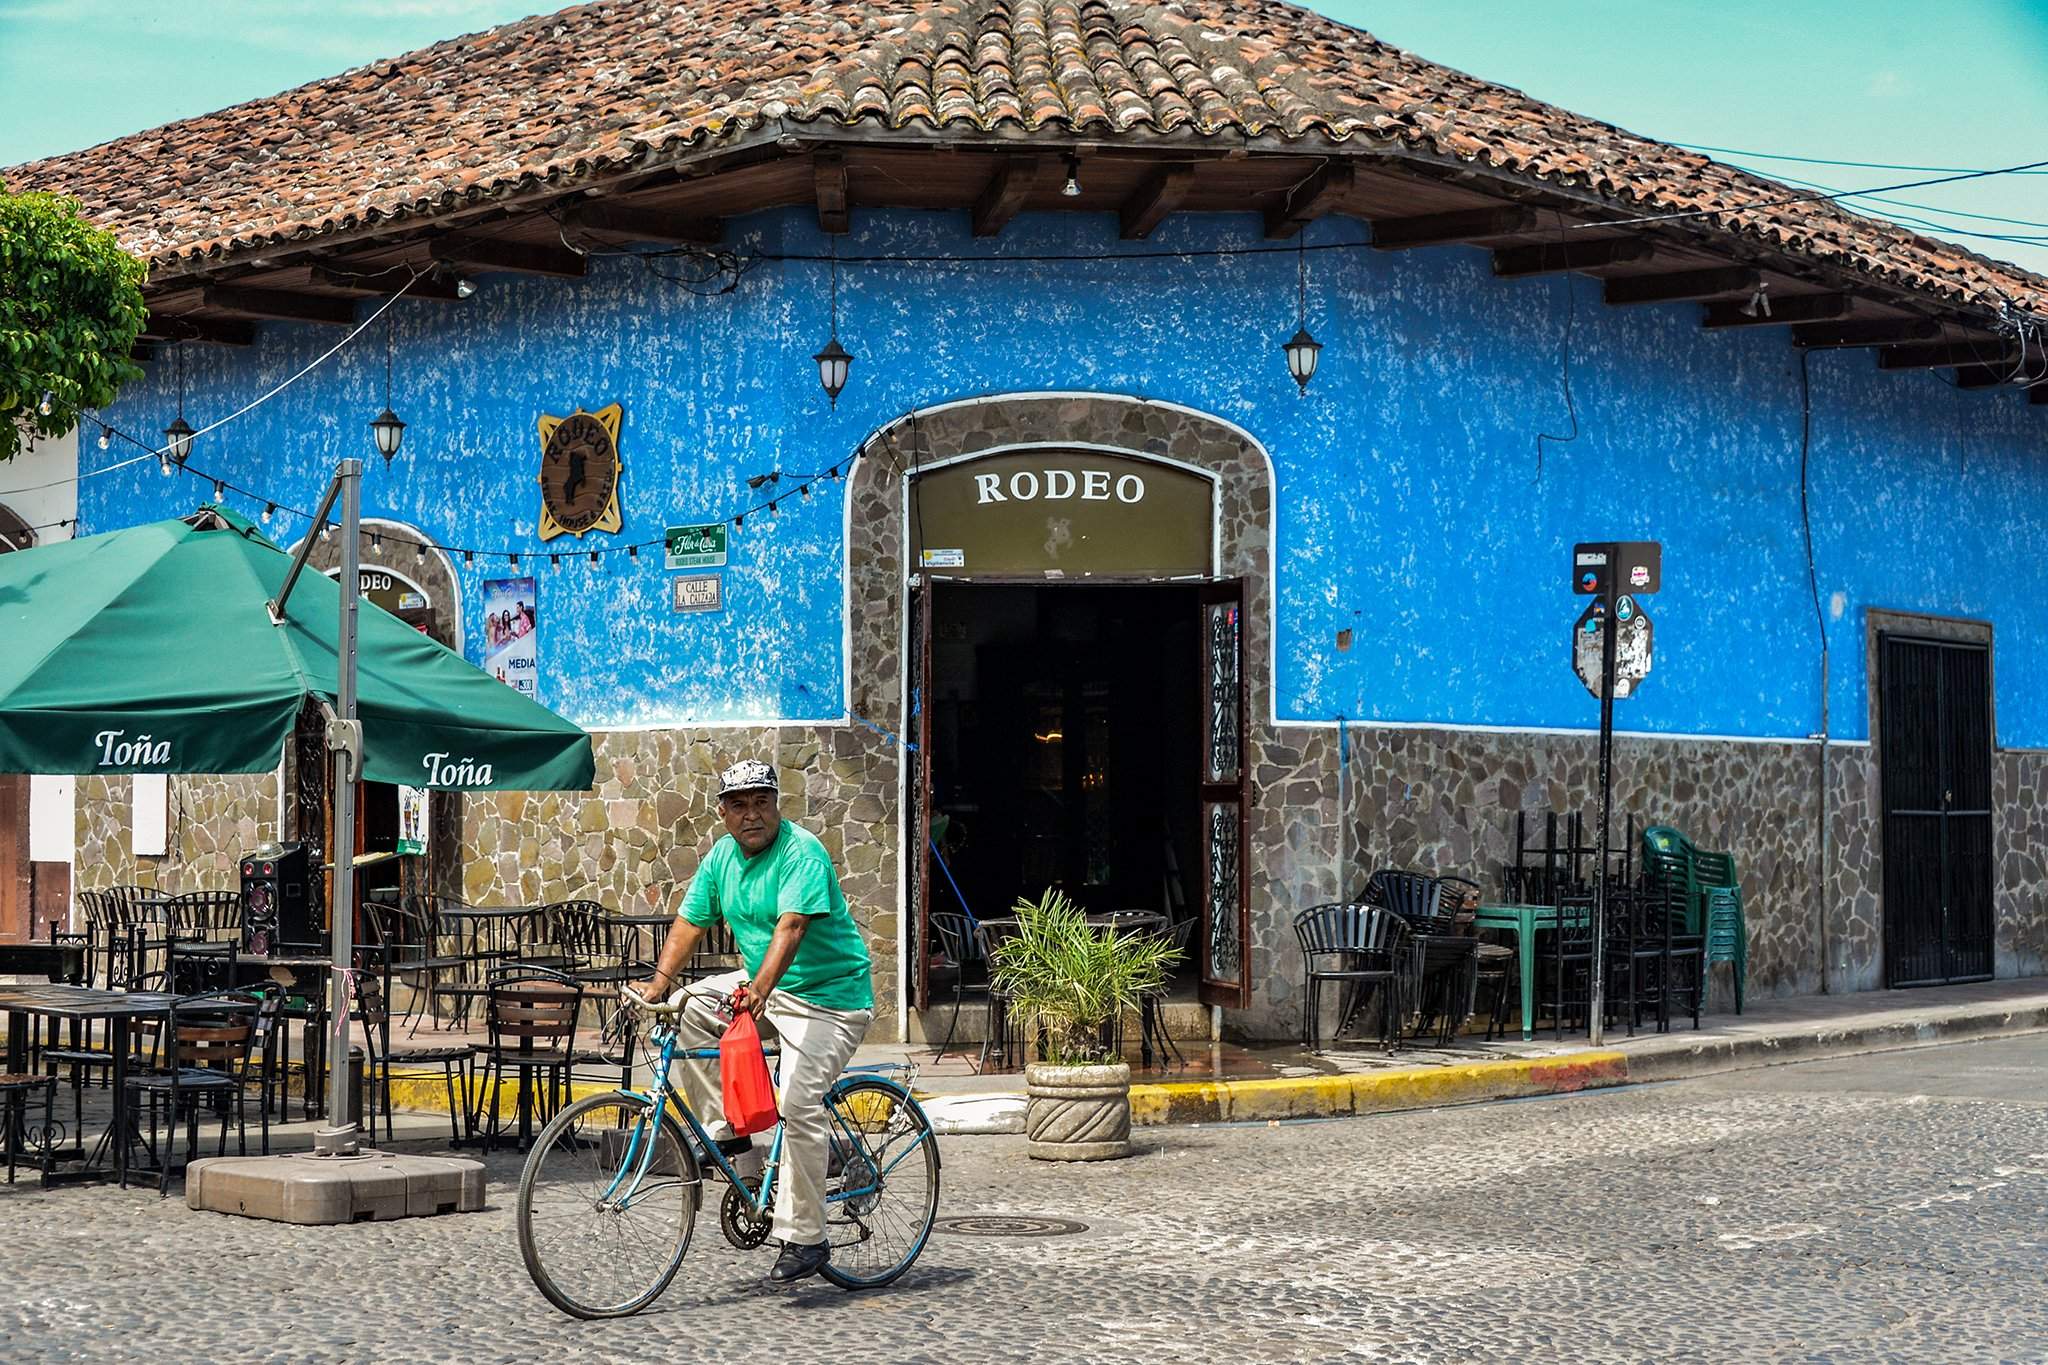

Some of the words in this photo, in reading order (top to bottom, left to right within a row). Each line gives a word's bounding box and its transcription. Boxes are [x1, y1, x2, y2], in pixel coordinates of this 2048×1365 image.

[548, 418, 609, 463] RODEO
[974, 470, 1145, 504] RODEO
[560, 514, 590, 528] HOUSE
[674, 535, 694, 555] Flor
[360, 574, 392, 591] DEO
[686, 581, 708, 593] CALLE
[678, 595, 686, 605] LA
[690, 592, 716, 604] CALZADA
[508, 658, 536, 669] MEDIA
[95, 729, 171, 766] Toña
[422, 752, 493, 786] Toña
